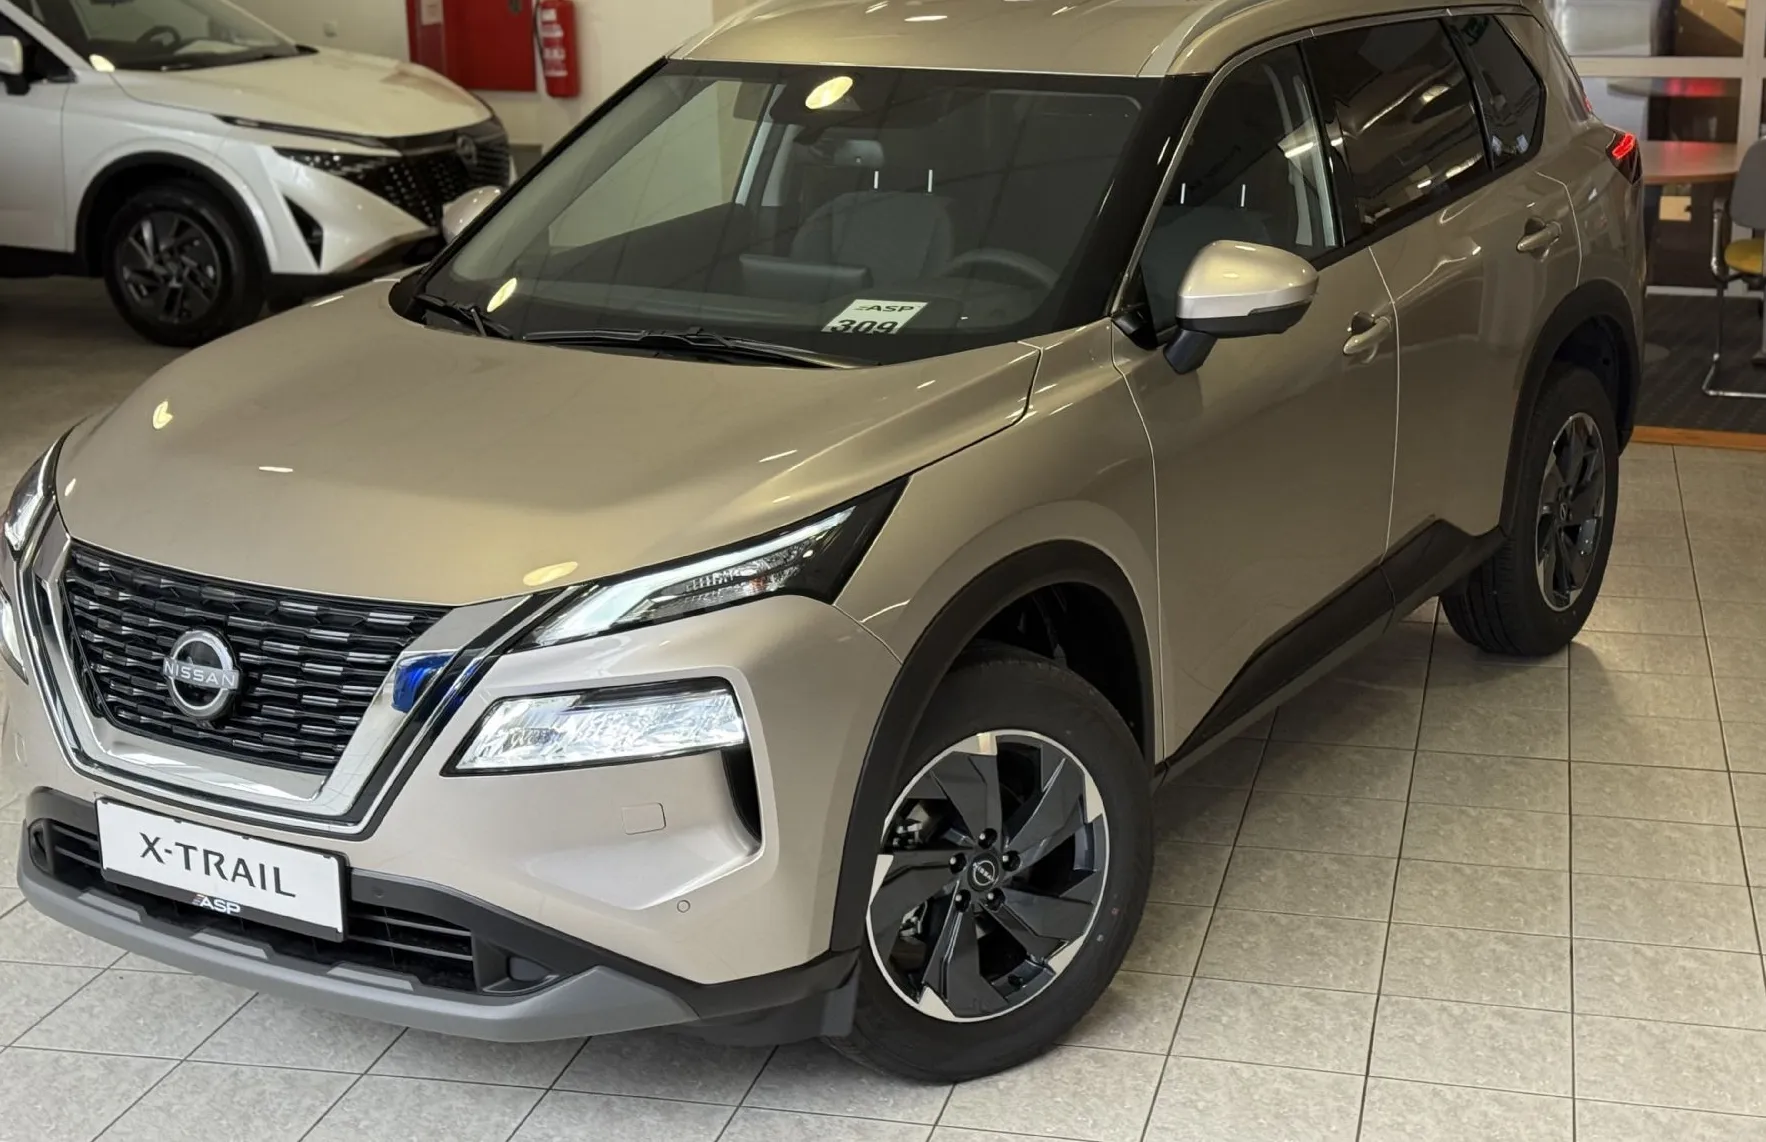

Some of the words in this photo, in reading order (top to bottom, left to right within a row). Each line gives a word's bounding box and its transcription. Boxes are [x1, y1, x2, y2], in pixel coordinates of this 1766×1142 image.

[866, 305, 915, 313] ASP
[164, 660, 235, 687] NISSAN
[139, 831, 296, 898] X-TRAIL
[199, 895, 241, 914] ASP
